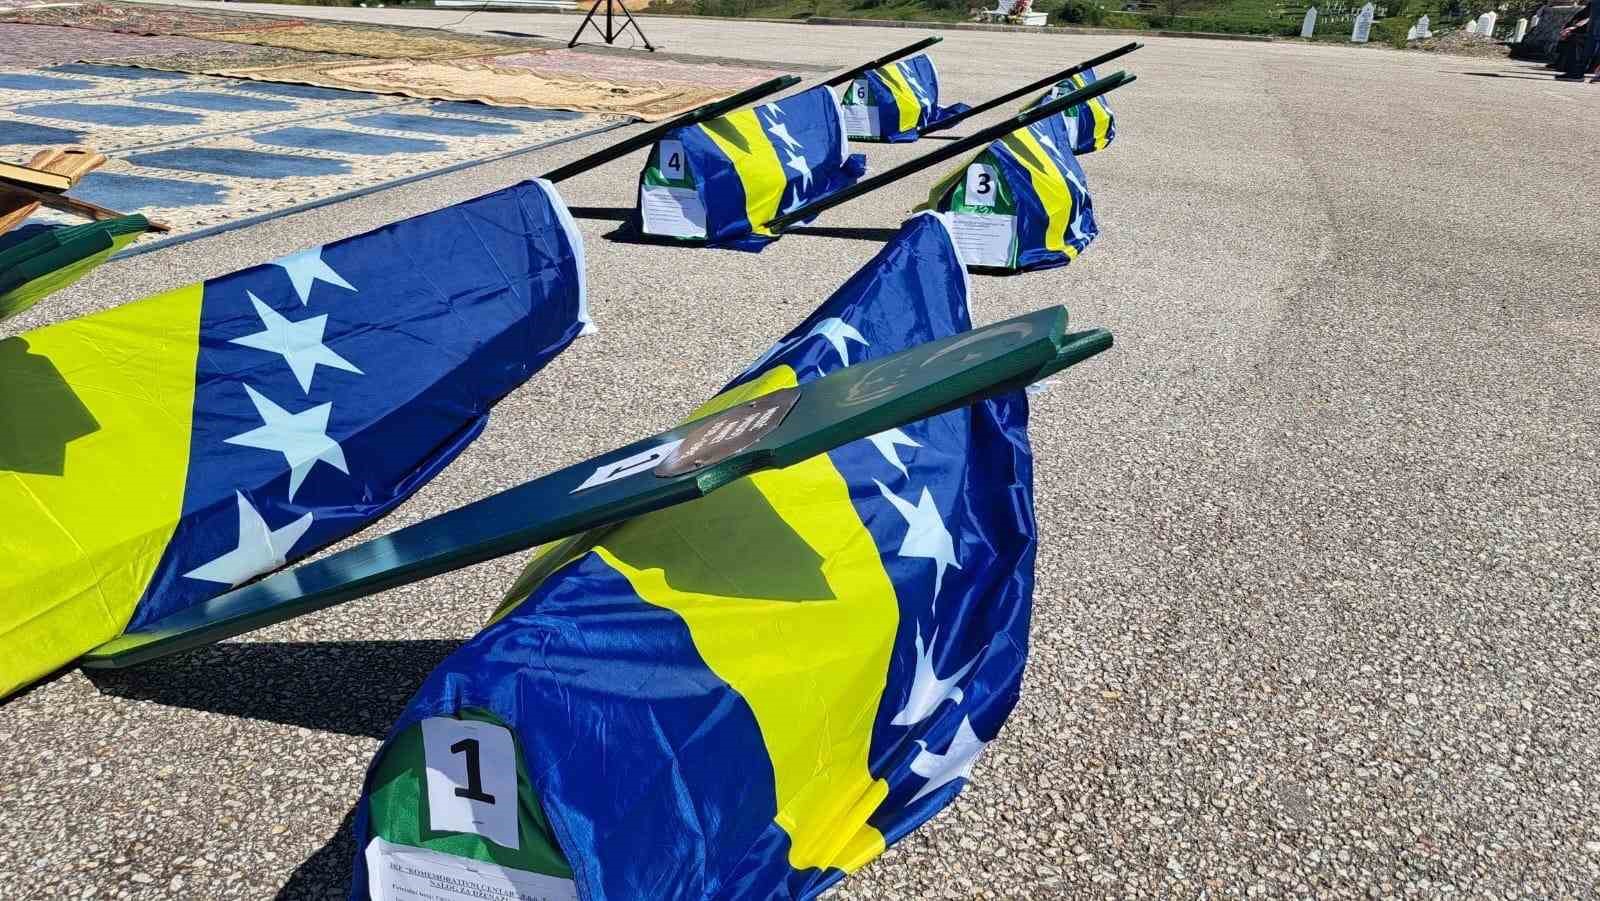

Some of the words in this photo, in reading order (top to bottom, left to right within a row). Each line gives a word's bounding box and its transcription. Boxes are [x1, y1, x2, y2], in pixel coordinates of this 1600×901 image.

[857, 87, 865, 99] 6
[668, 152, 681, 171] 4
[977, 173, 991, 194] 3
[450, 738, 496, 805] 1
